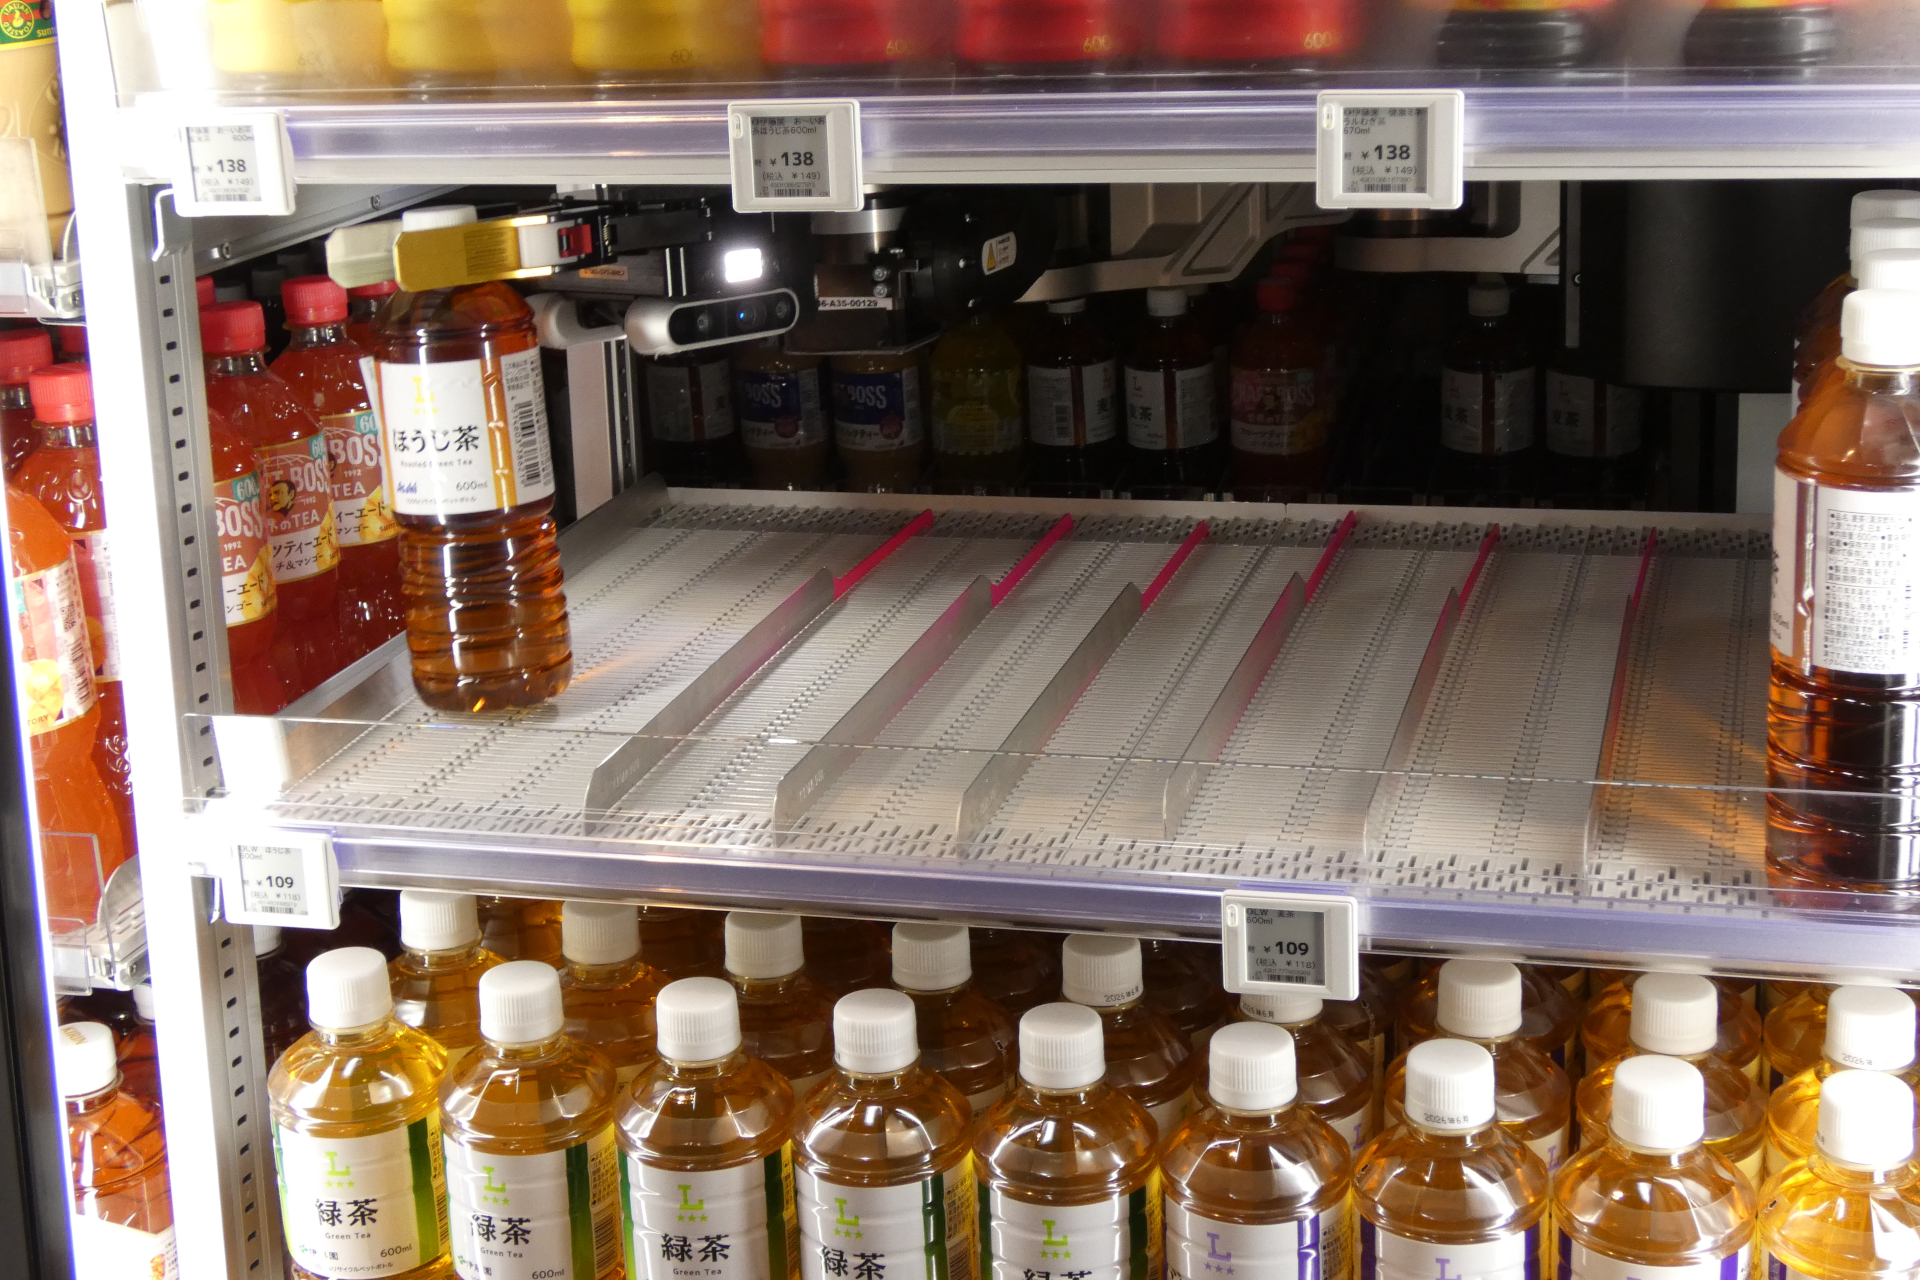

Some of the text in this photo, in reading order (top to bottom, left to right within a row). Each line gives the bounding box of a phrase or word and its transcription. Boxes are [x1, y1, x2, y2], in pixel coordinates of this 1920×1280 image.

[3, 3, 30, 15] ITALIAN
[3, 21, 32, 36] ROASTED
[1344, 127, 1371, 135] 670ml
[393, 425, 480, 453] ほうじ茶
[344, 469, 362, 478] 1992
[457, 480, 488, 492] 600ml
[223, 540, 242, 552] 1992
[1246, 916, 1273, 925] 600ml
[1277, 910, 1295, 918] 麦茶
[61, 1026, 87, 1046] KIRIN
[1424, 1113, 1470, 1125] 2026年6月
[324, 1152, 352, 1177] L
[482, 1166, 507, 1193] L
[677, 1184, 704, 1210] L
[315, 1198, 378, 1227] 緑茶
[835, 1197, 860, 1227] L
[325, 1232, 371, 1240] Green Tea
[470, 1213, 532, 1245] 緑茶
[1042, 1219, 1068, 1247] L
[380, 1243, 412, 1258] 600ml
[480, 1246, 523, 1259] Green Tea
[661, 1233, 731, 1263] 緑茶
[1207, 1231, 1232, 1262] L
[821, 1246, 886, 1280] 緑茶
[531, 1268, 565, 1280] 600ml
[673, 1267, 700, 1276] Green
